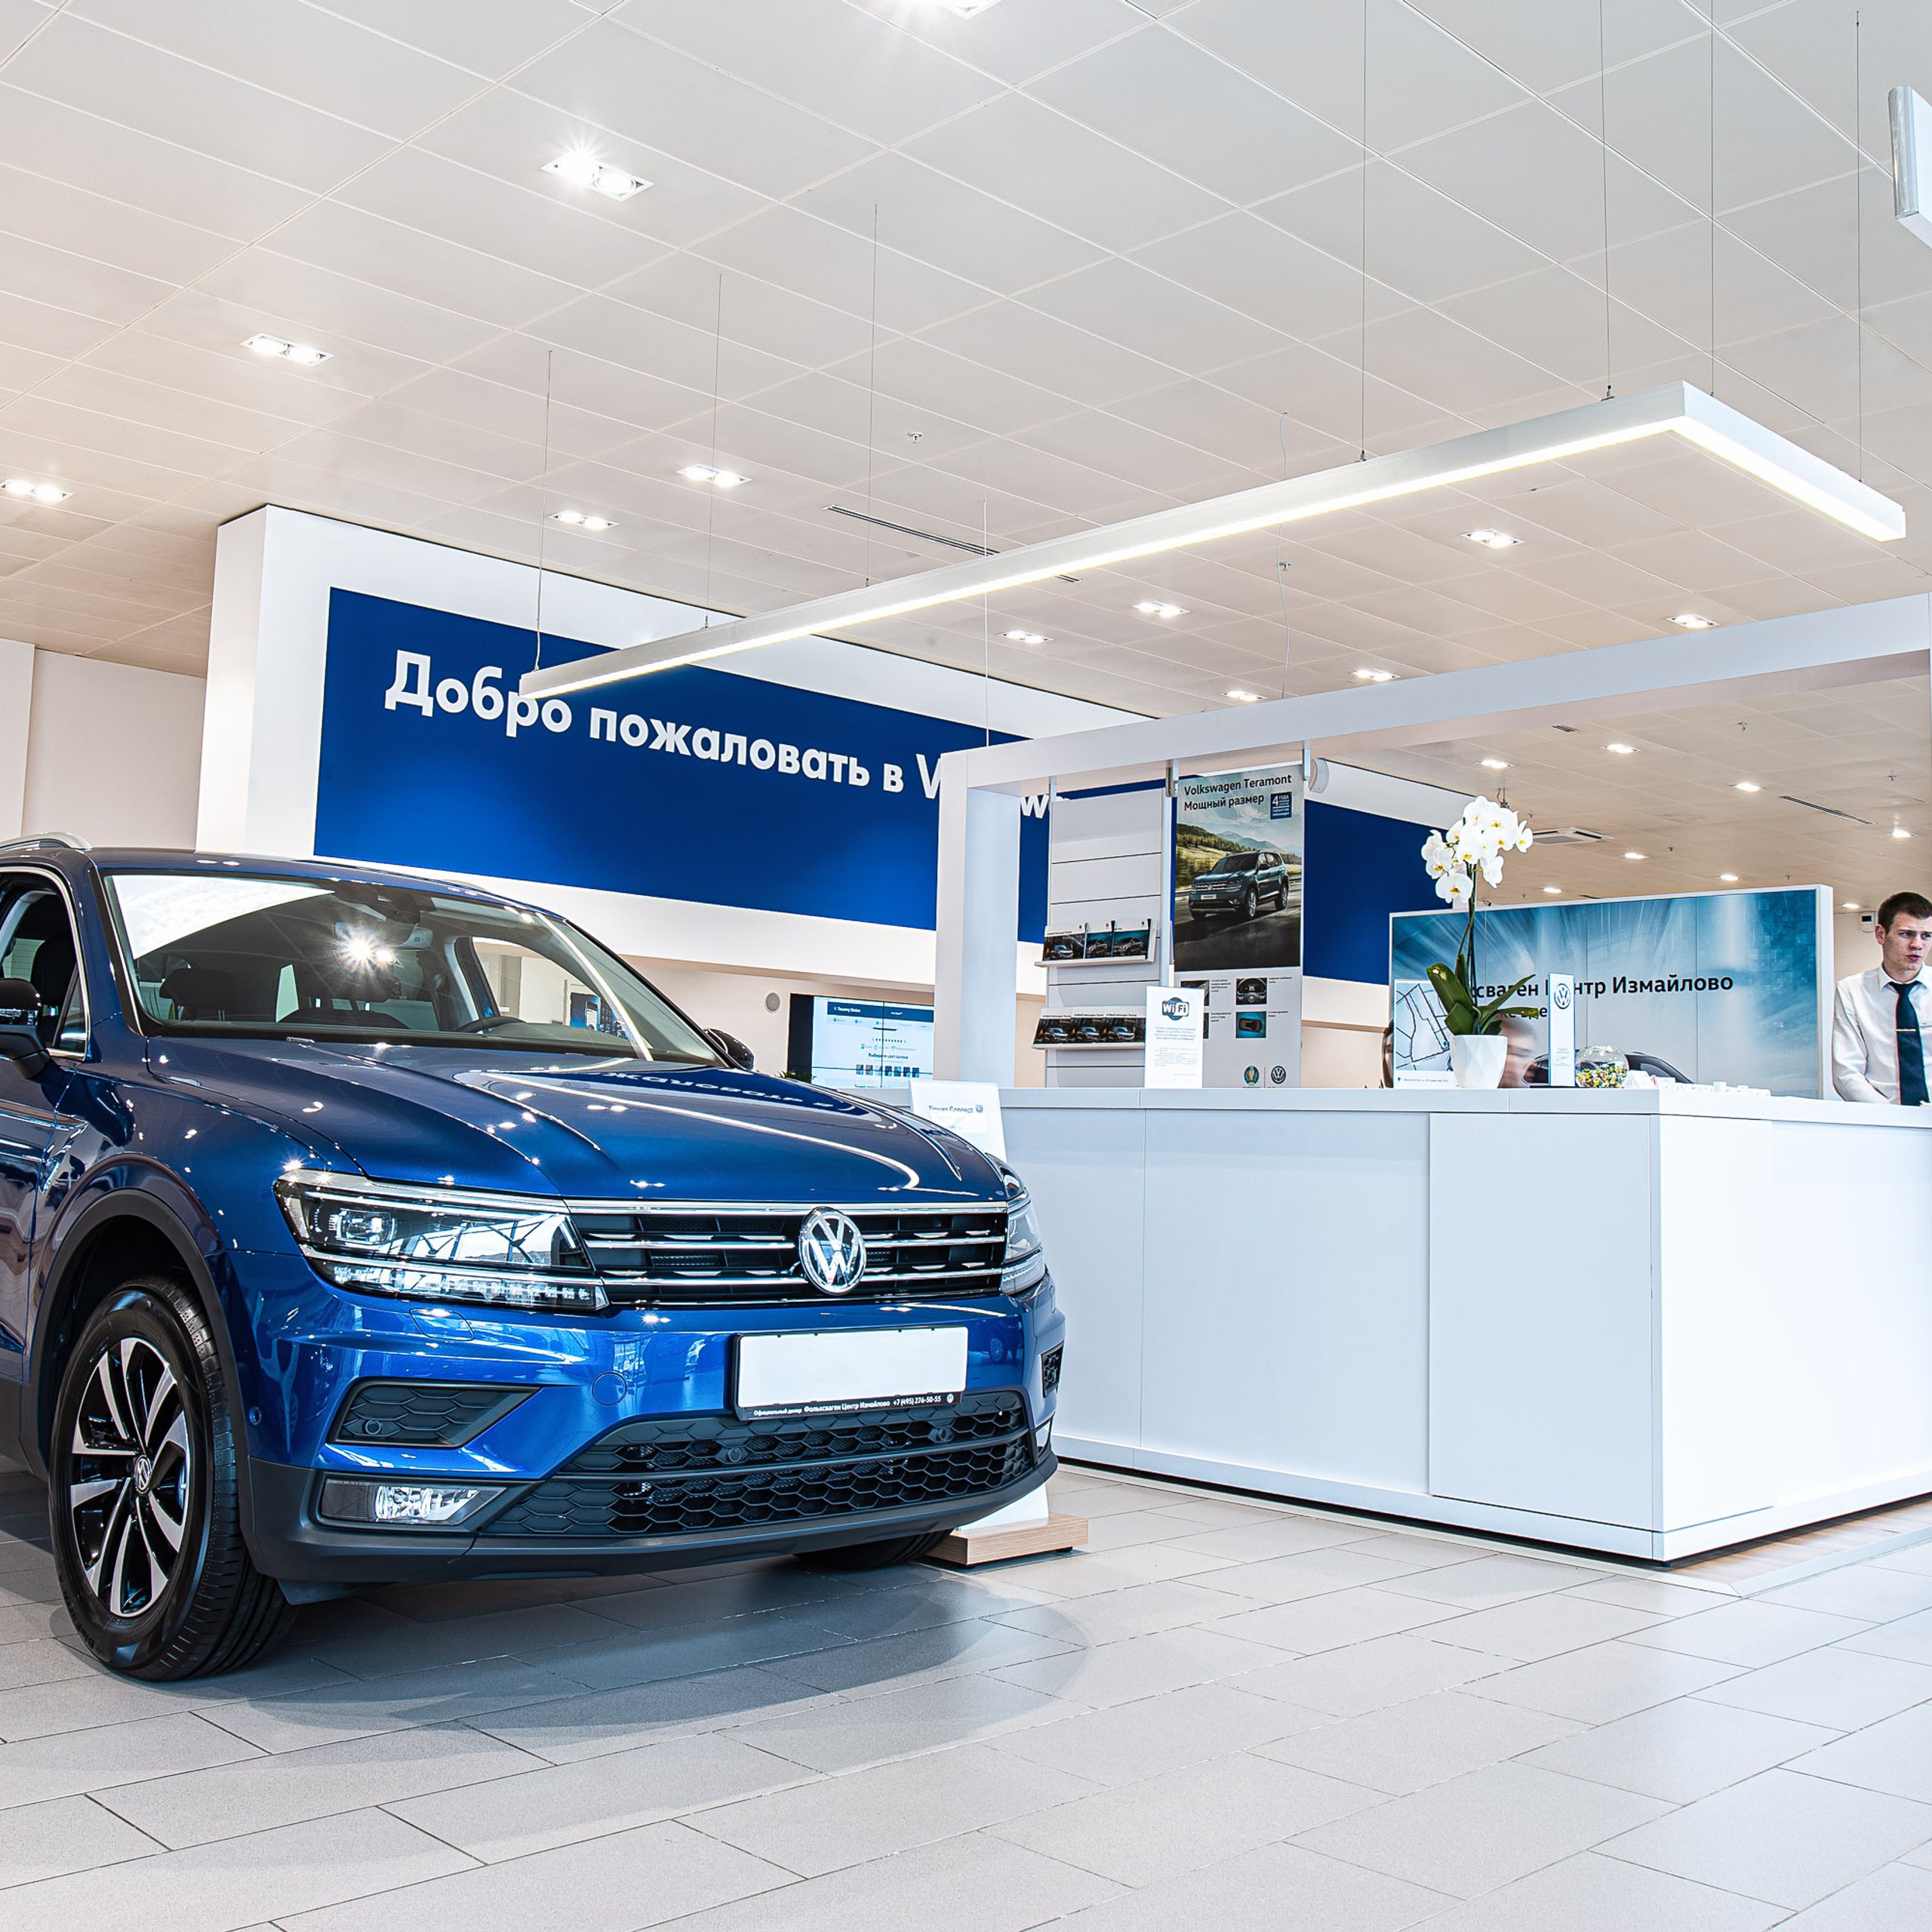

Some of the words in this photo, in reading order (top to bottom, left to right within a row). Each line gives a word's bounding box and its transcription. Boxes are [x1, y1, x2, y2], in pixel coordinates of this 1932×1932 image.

[385, 650, 572, 738] Добро
[589, 707, 870, 786] пожаловать
[883, 763, 903, 793] в
[1184, 782, 1241, 795] Volkswagen
[1244, 774, 1291, 789] Teramont
[1184, 797, 1226, 811] Мощный
[1229, 795, 1264, 808] размер
[1272, 795, 1278, 807] 4
[1613, 974, 1734, 994] Измайлово
